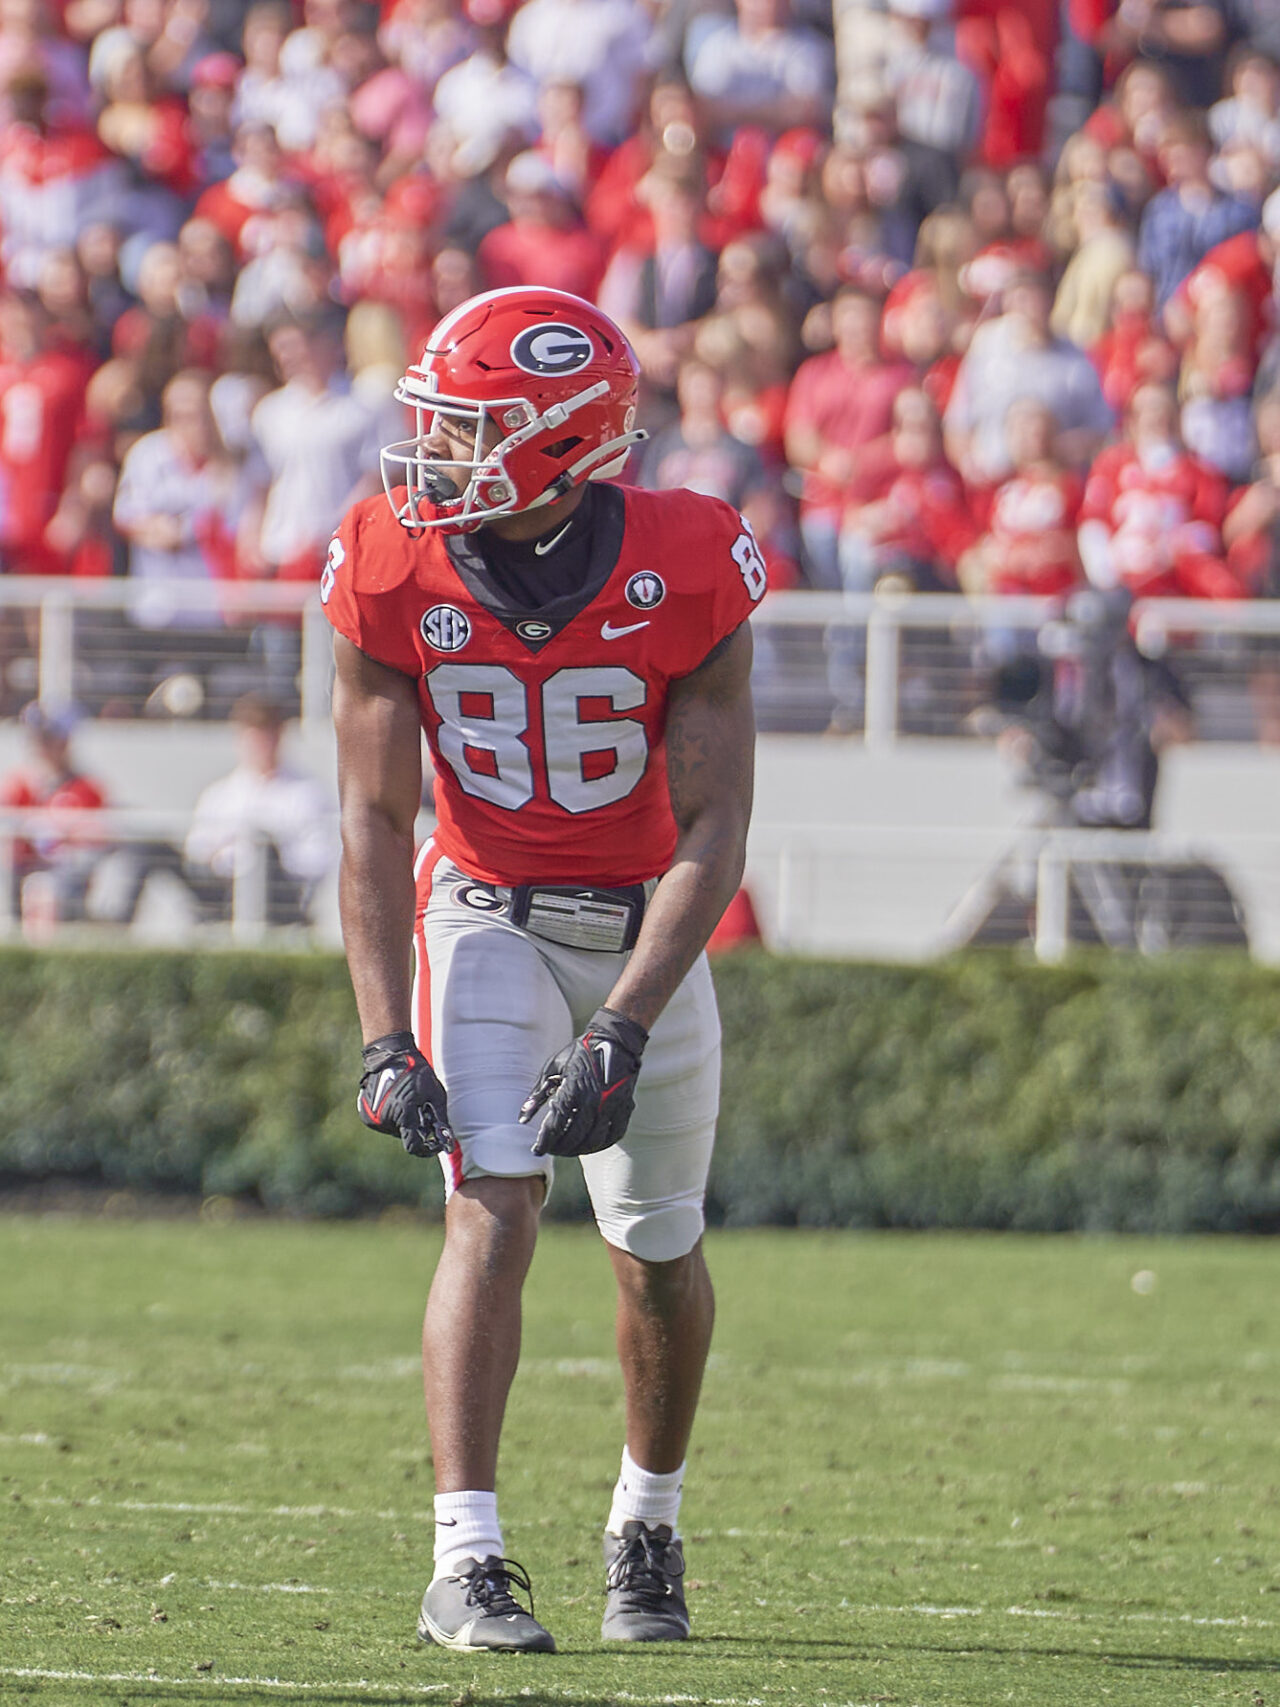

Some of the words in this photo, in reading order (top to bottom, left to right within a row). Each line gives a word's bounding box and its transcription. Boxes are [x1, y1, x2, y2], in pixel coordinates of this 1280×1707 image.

[511, 322, 593, 377] G
[730, 513, 768, 602] 8
[423, 606, 469, 649] SEC
[516, 620, 551, 640] G
[424, 662, 648, 814] 86
[452, 882, 506, 914] G
